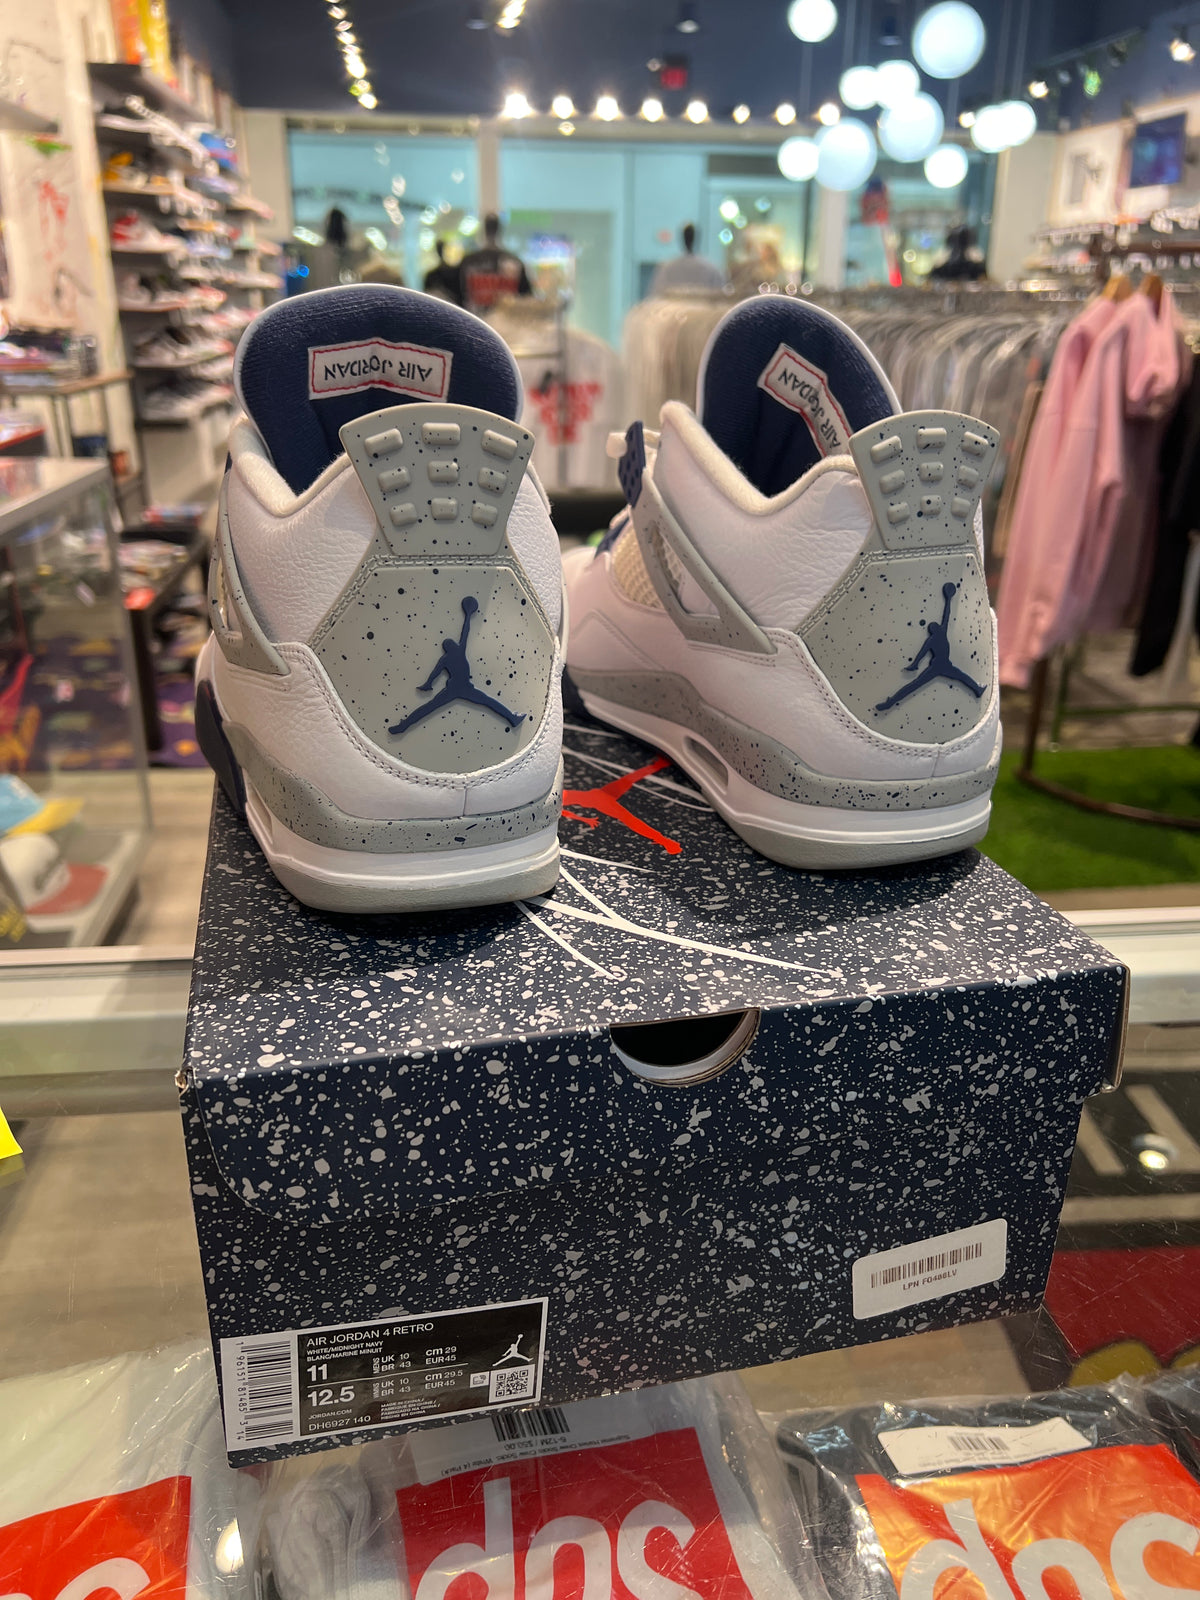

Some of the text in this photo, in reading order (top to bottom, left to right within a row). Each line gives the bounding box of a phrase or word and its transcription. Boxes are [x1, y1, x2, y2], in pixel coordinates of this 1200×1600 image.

[324, 355, 433, 382] AIR JORDAN
[820, 418, 841, 449] AIR
[902, 1280, 920, 1291] LPN
[306, 1322, 434, 1347] AIR JORDAN 4 RETRO
[306, 1340, 384, 1356] WHITE/MIDNIGHT NAVY
[306, 1347, 383, 1362] BLANC/MARINE MINUIT
[425, 1346, 457, 1357] cm 29
[381, 1352, 410, 1363] UK 10
[236, 1355, 246, 1382] 96151
[306, 1363, 328, 1382] 11
[381, 1360, 412, 1372] BR 43
[425, 1369, 463, 1381] cm 29.5
[381, 1380, 394, 1388] UK
[237, 1387, 248, 1412] 81485
[307, 1385, 356, 1407] 12.5
[381, 1388, 394, 1397] BR
[308, 1408, 353, 1420] JORDAN.COM
[308, 1415, 371, 1431] DH6927 140
